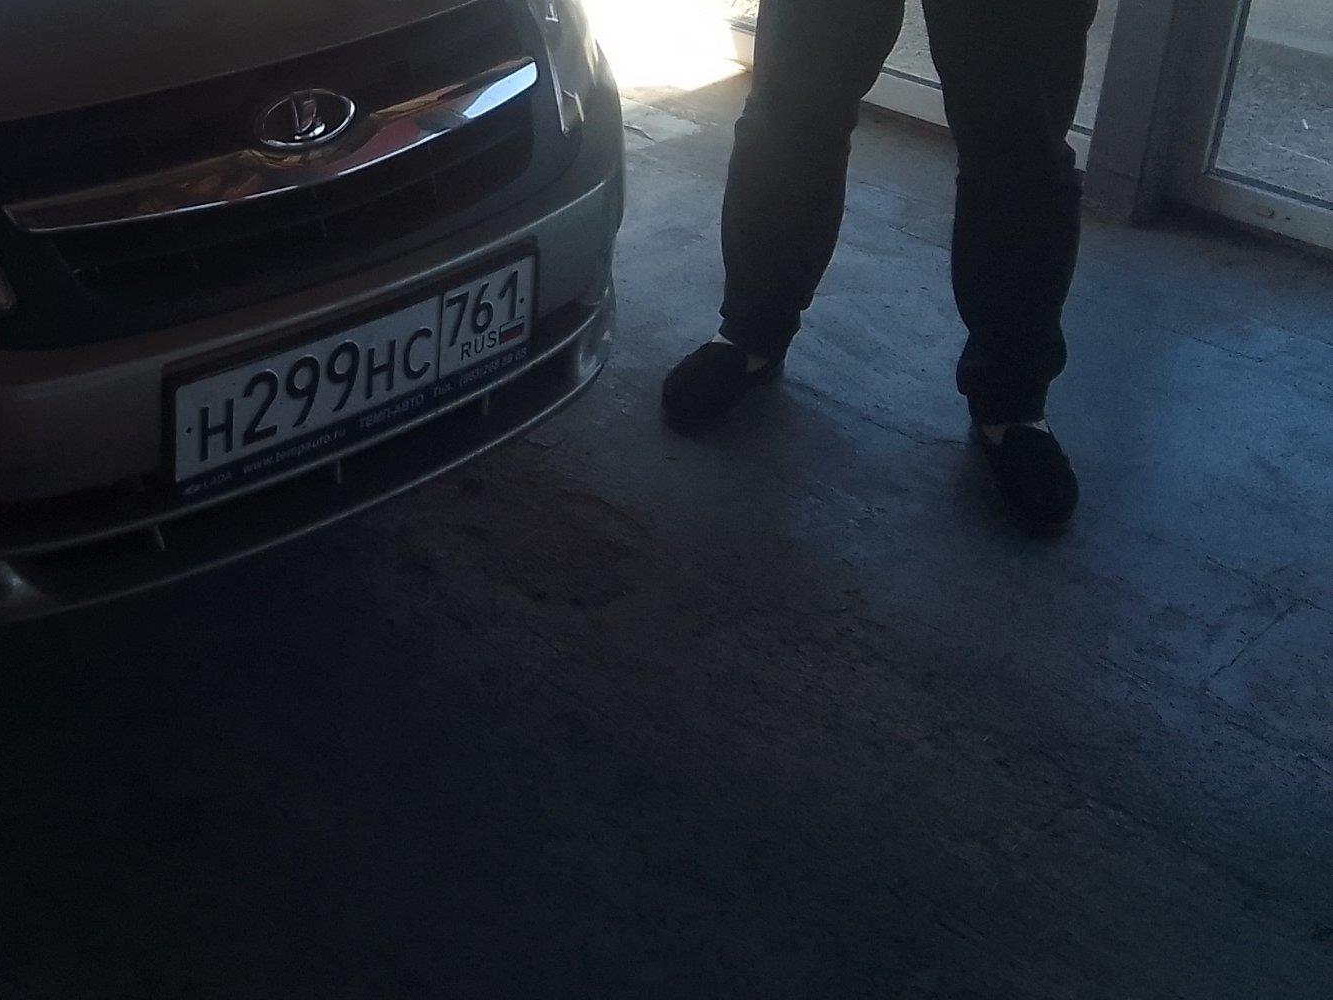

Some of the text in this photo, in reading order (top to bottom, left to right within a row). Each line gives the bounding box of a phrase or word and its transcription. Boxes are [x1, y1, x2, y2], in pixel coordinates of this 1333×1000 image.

[199, 325, 434, 462] Н299НС
[445, 268, 521, 347] 761
[460, 332, 498, 370] RUS
